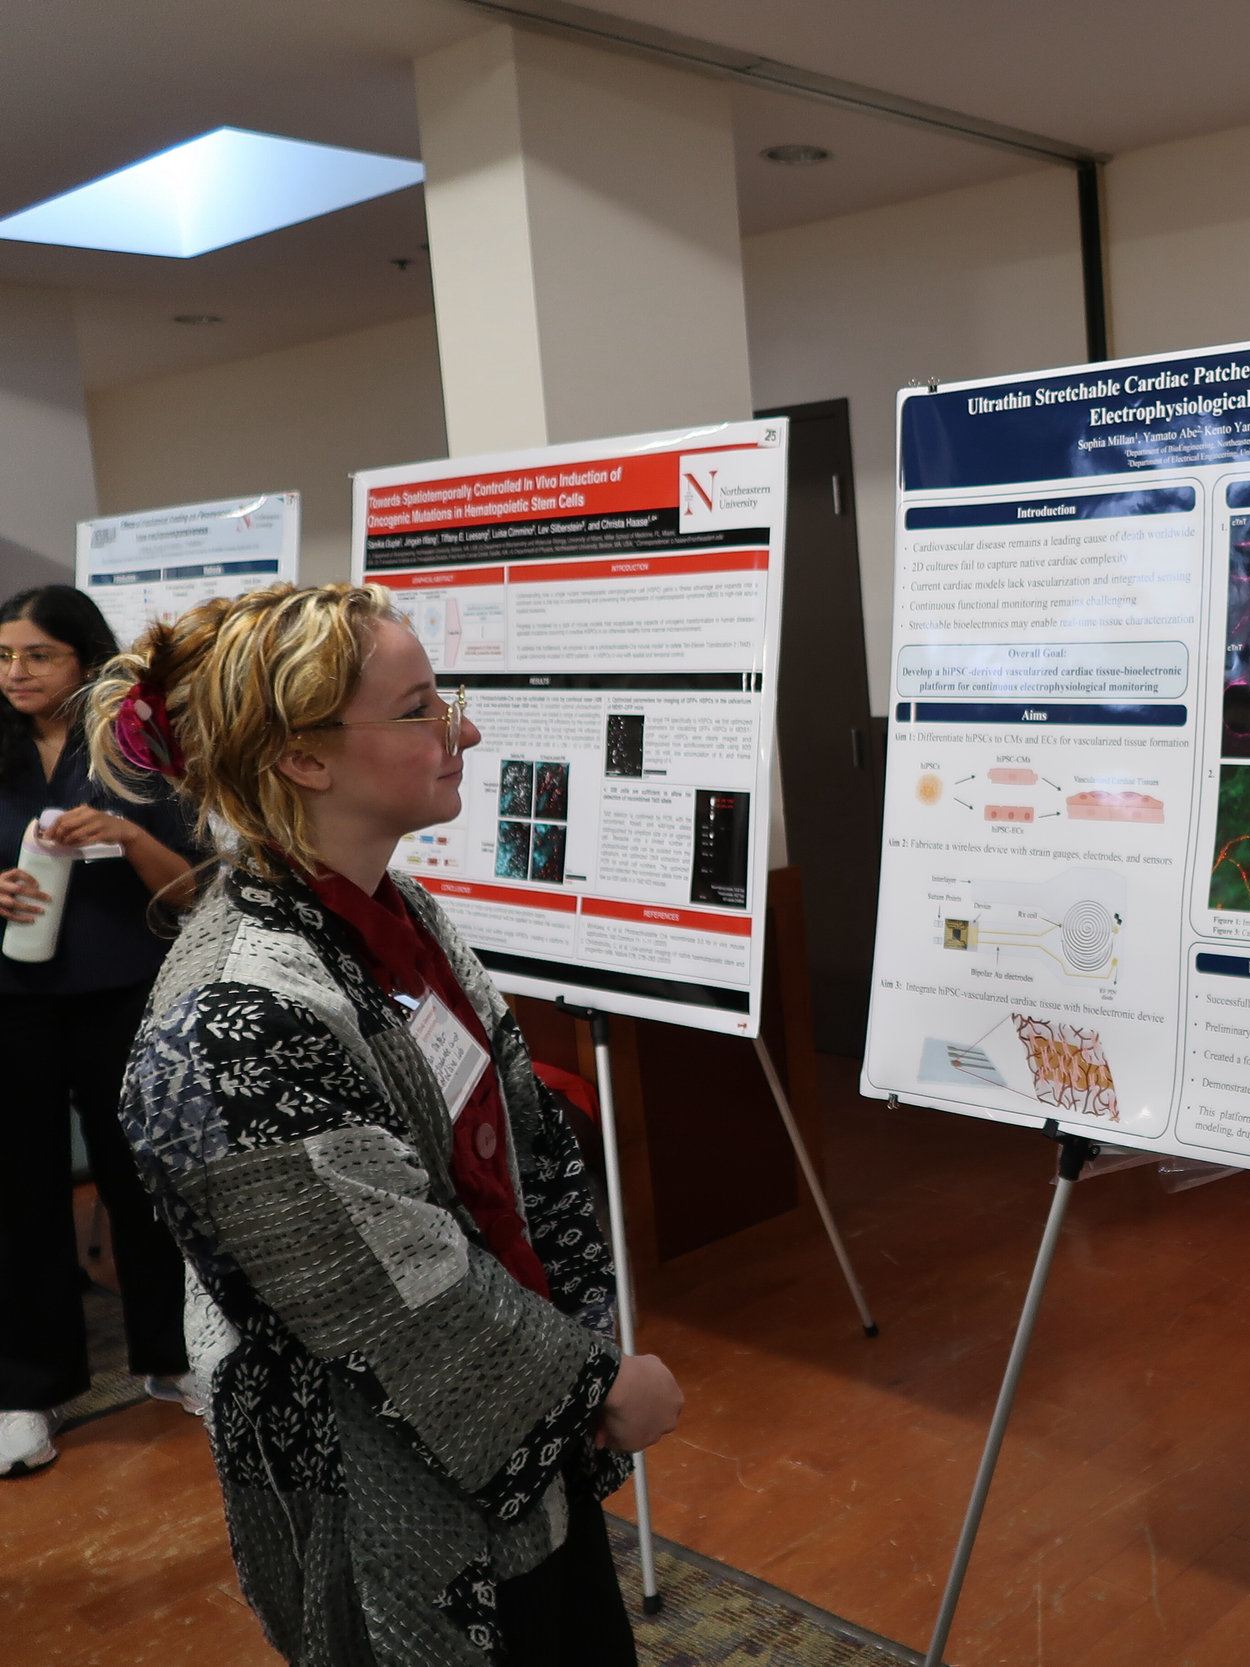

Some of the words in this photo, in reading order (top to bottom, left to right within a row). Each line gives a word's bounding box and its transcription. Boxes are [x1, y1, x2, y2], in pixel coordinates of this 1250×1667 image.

[968, 391, 1031, 416] Ultrathin
[1034, 378, 1120, 406] Stretchable
[1124, 371, 1188, 394] Cardiac
[764, 429, 777, 442] 25
[401, 484, 472, 508] Spatiotemporally
[473, 478, 522, 497] Controlled
[535, 476, 558, 490] Vivo
[559, 470, 608, 488] Induction
[609, 467, 622, 482] of
[719, 485, 771, 497] Northeastern
[719, 498, 758, 509] University
[368, 511, 410, 529] Oncogenic
[411, 508, 452, 522] Mutations
[453, 506, 463, 518] in
[464, 499, 528, 518] Hematopoietic
[530, 498, 556, 511] Stem
[558, 494, 584, 509] Cells
[1017, 504, 1076, 519] Introduction
[1231, 518, 1248, 526] cTnT
[913, 540, 974, 552] Cardiovascular
[976, 539, 1006, 550] disease
[1008, 537, 1041, 548] remains
[1050, 535, 1081, 548] leading
[611, 563, 649, 572] INTRODUCTION
[925, 561, 958, 571] cultures
[960, 559, 974, 570] fail
[986, 560, 1018, 572] capture
[1019, 557, 1045, 568] native
[1047, 555, 1077, 566] cardiac
[1079, 554, 1127, 567] complexity
[910, 581, 940, 592] Current
[942, 580, 972, 591] cardiac
[974, 578, 1005, 590] models
[1007, 577, 1026, 588] lack
[1027, 576, 1090, 588] vascularization
[1092, 574, 1108, 585] and
[1110, 572, 1154, 586] integrated
[909, 600, 955, 611] Continuous
[957, 598, 999, 610] functional
[1001, 598, 1048, 611] monitoring
[1049, 597, 1083, 608] remains
[1085, 595, 1136, 608] challenging
[1008, 648, 1040, 658] Overall
[1042, 648, 1066, 658] Goal:
[903, 667, 932, 678] Develop
[529, 677, 550, 686] RESULTS
[920, 682, 955, 694] platform
[1019, 682, 1106, 694] electrophysiological
[1108, 683, 1158, 694] monitoring
[1021, 710, 1047, 721] Aims
[965, 732, 992, 743] hiPSCs
[1024, 734, 1039, 744] and
[1073, 735, 1122, 746] vascularized
[1149, 736, 1188, 747] formation
[1208, 769, 1215, 778] 2.
[643, 909, 680, 922] REFERENCES
[906, 982, 936, 996] Integrate
[937, 985, 1008, 1004] hiPSC-vascularized
[1009, 996, 1038, 1008] cardiac
[1039, 999, 1061, 1010] tissue
[1063, 1002, 1081, 1013] with
[1082, 1003, 1135, 1020] bioelectronic
[1136, 1010, 1164, 1023] device
[1204, 1050, 1235, 1064] Created
[1199, 1105, 1215, 1118] This
